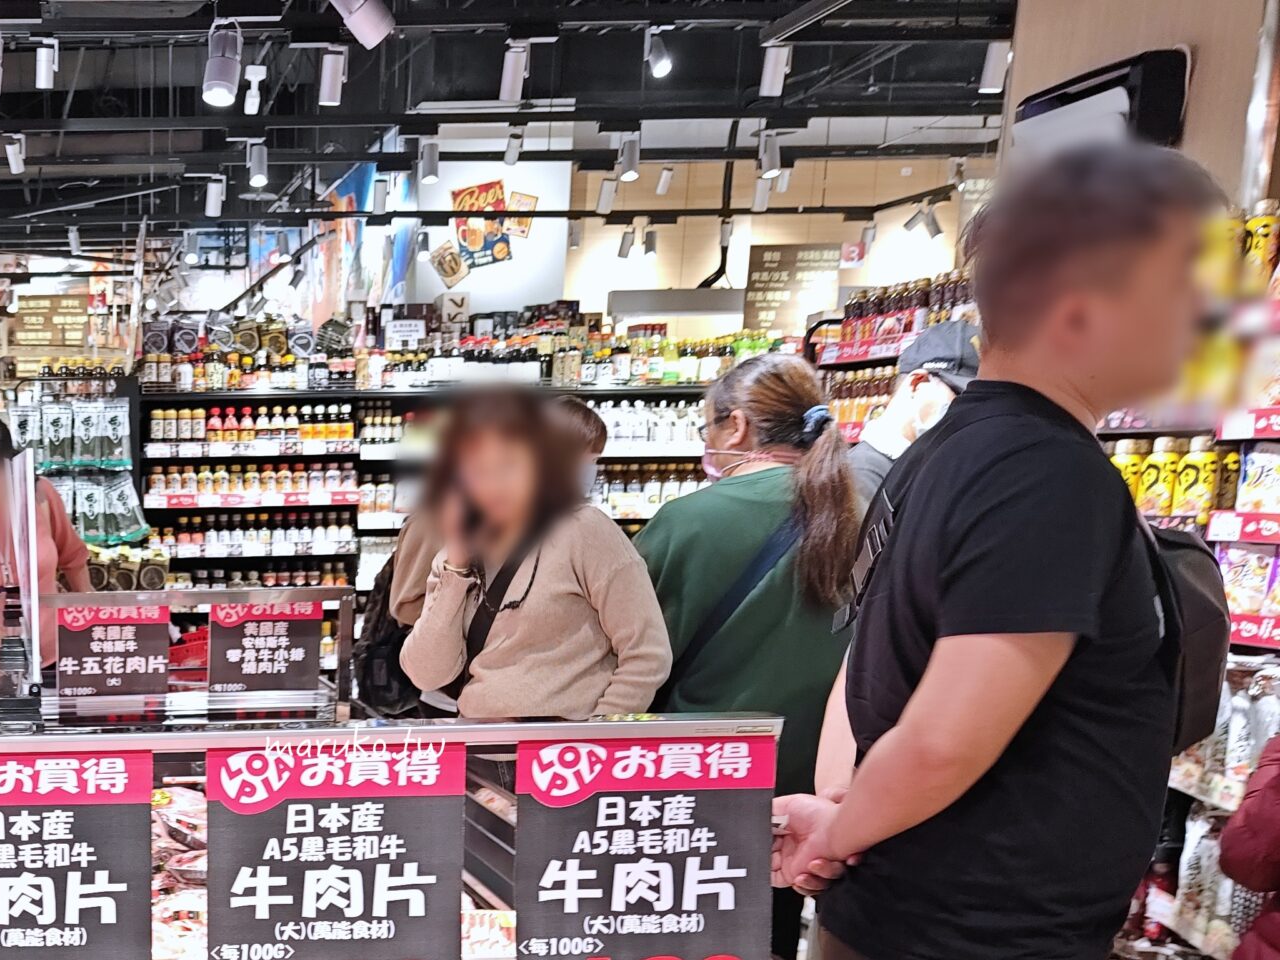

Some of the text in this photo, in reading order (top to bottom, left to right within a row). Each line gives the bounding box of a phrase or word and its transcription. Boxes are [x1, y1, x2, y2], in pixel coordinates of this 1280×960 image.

[58, 655, 169, 675] 牛五花肉片
[300, 750, 441, 787] お買得
[611, 742, 752, 779] お買得
[229, 862, 437, 920] 牛肉片
[537, 855, 748, 914] 牛肉片
